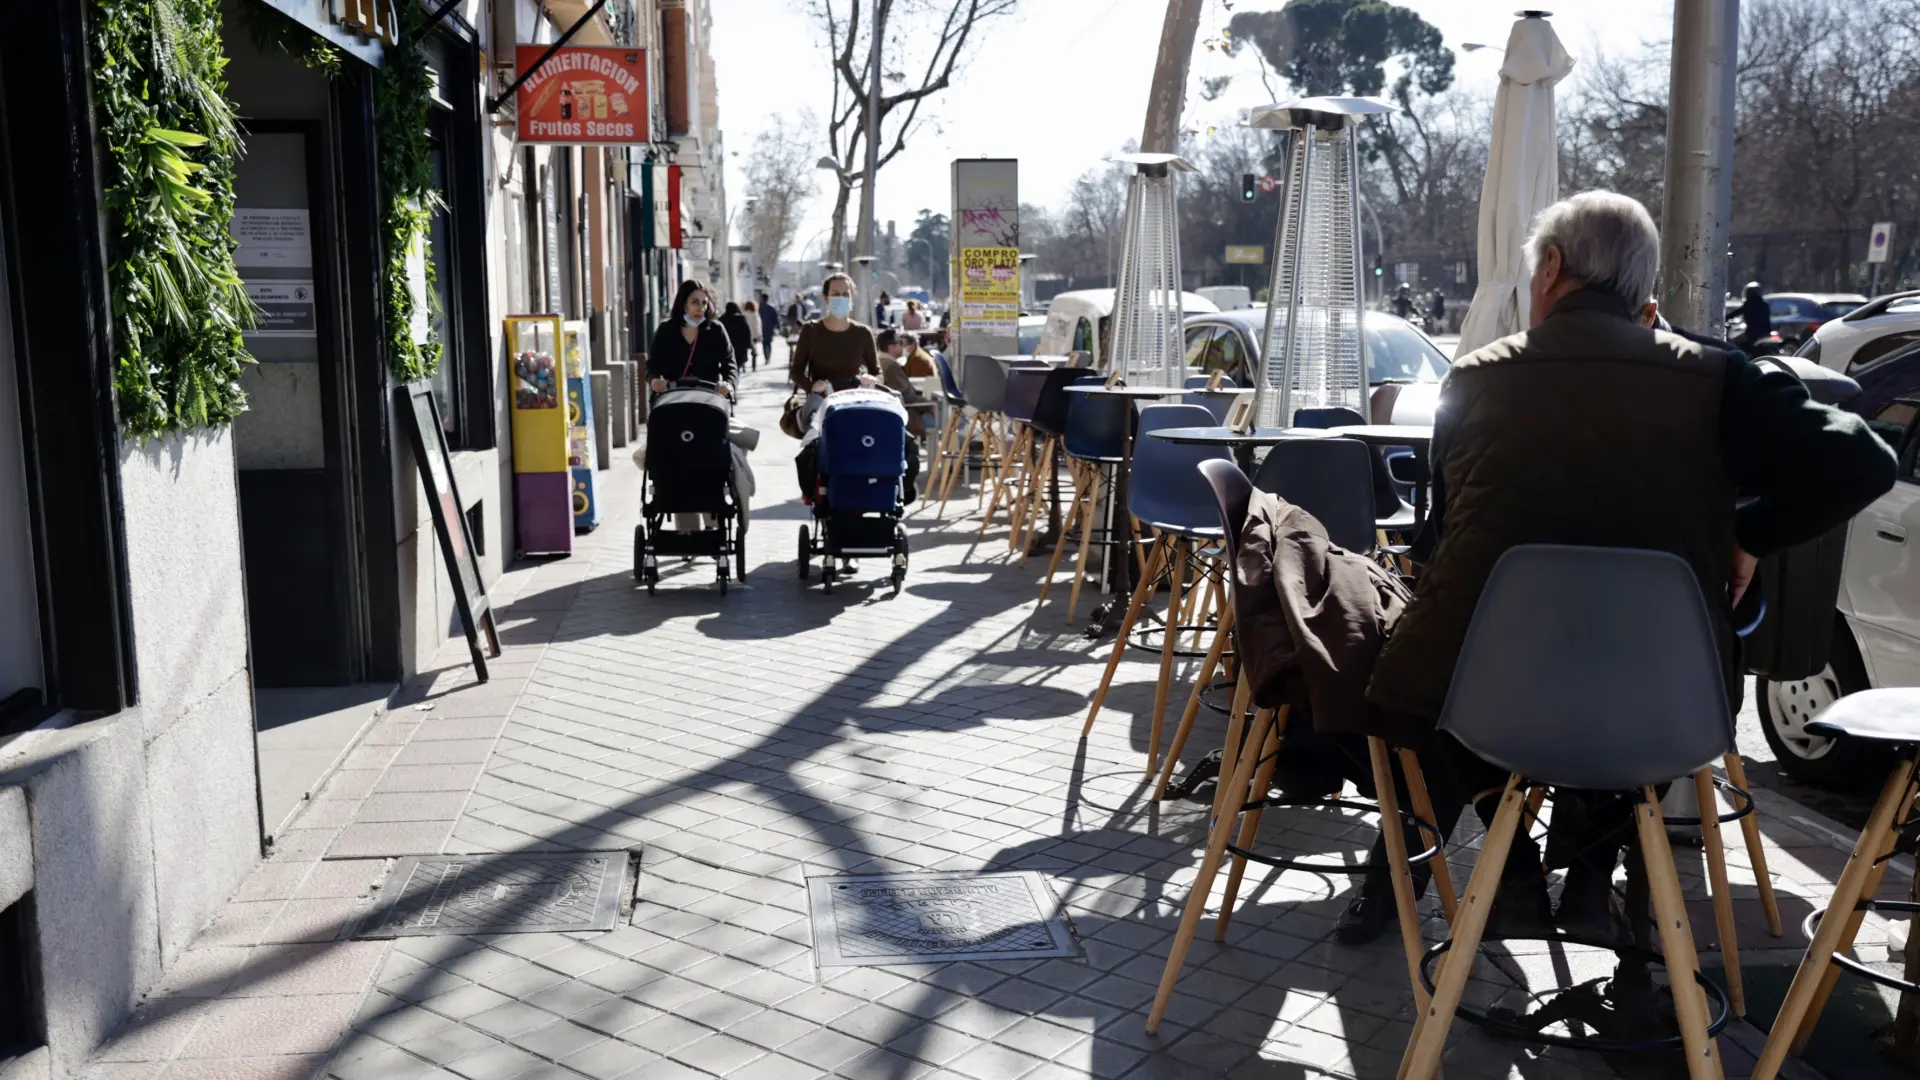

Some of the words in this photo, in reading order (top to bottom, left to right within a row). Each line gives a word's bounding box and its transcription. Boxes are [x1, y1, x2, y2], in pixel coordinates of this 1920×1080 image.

[522, 51, 640, 96] ALIMENTACION
[530, 119, 582, 136] Frutos
[586, 119, 634, 137] Secos
[964, 249, 1018, 259] COMPRO
